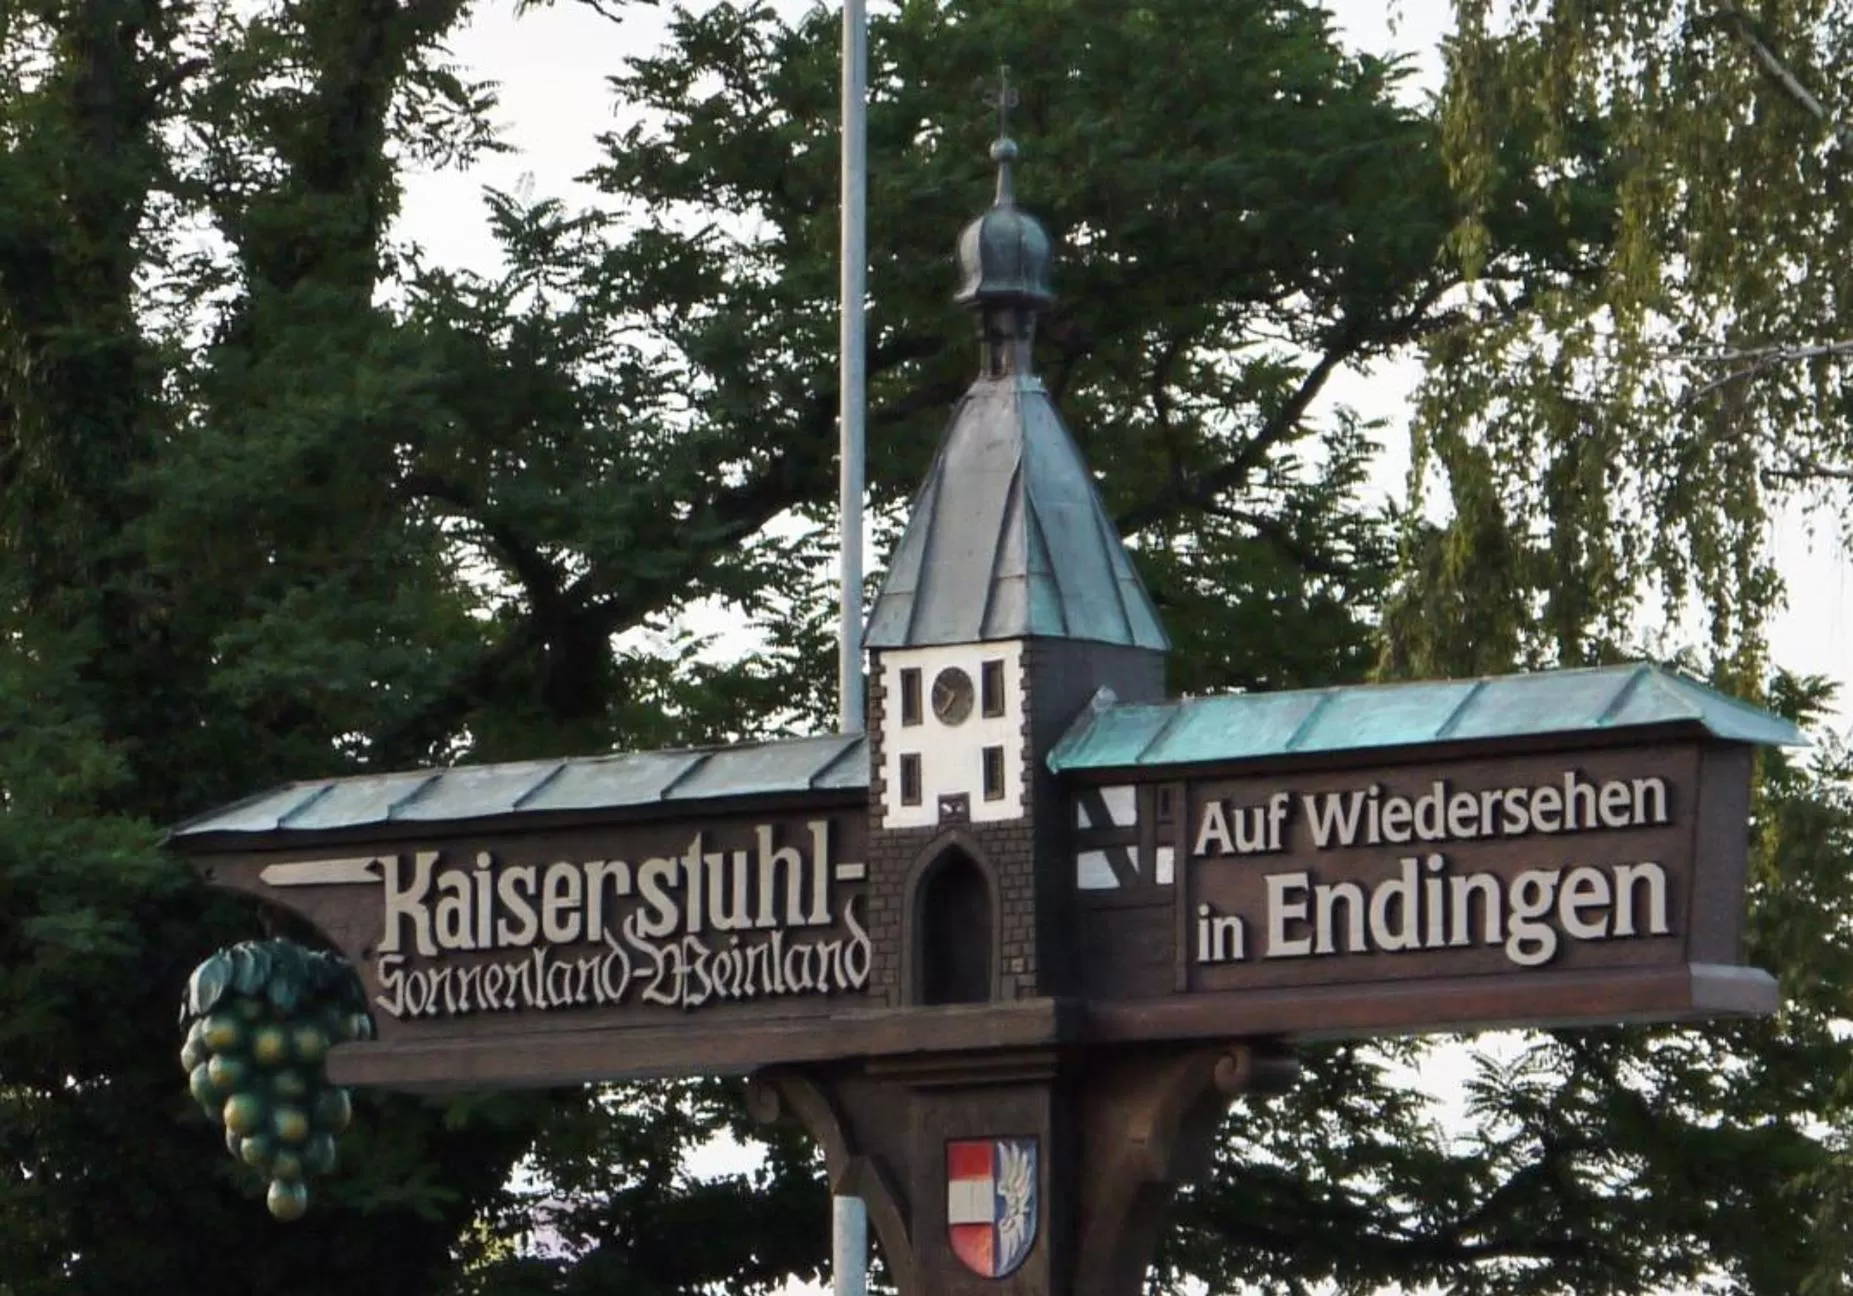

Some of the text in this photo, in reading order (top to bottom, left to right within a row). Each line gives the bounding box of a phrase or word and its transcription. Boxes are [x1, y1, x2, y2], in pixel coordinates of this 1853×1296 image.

[1193, 772, 1668, 855] Auf Wiedersehen
[375, 820, 865, 956] Kaiserstuhl-
[1197, 854, 1669, 966] in Endingen
